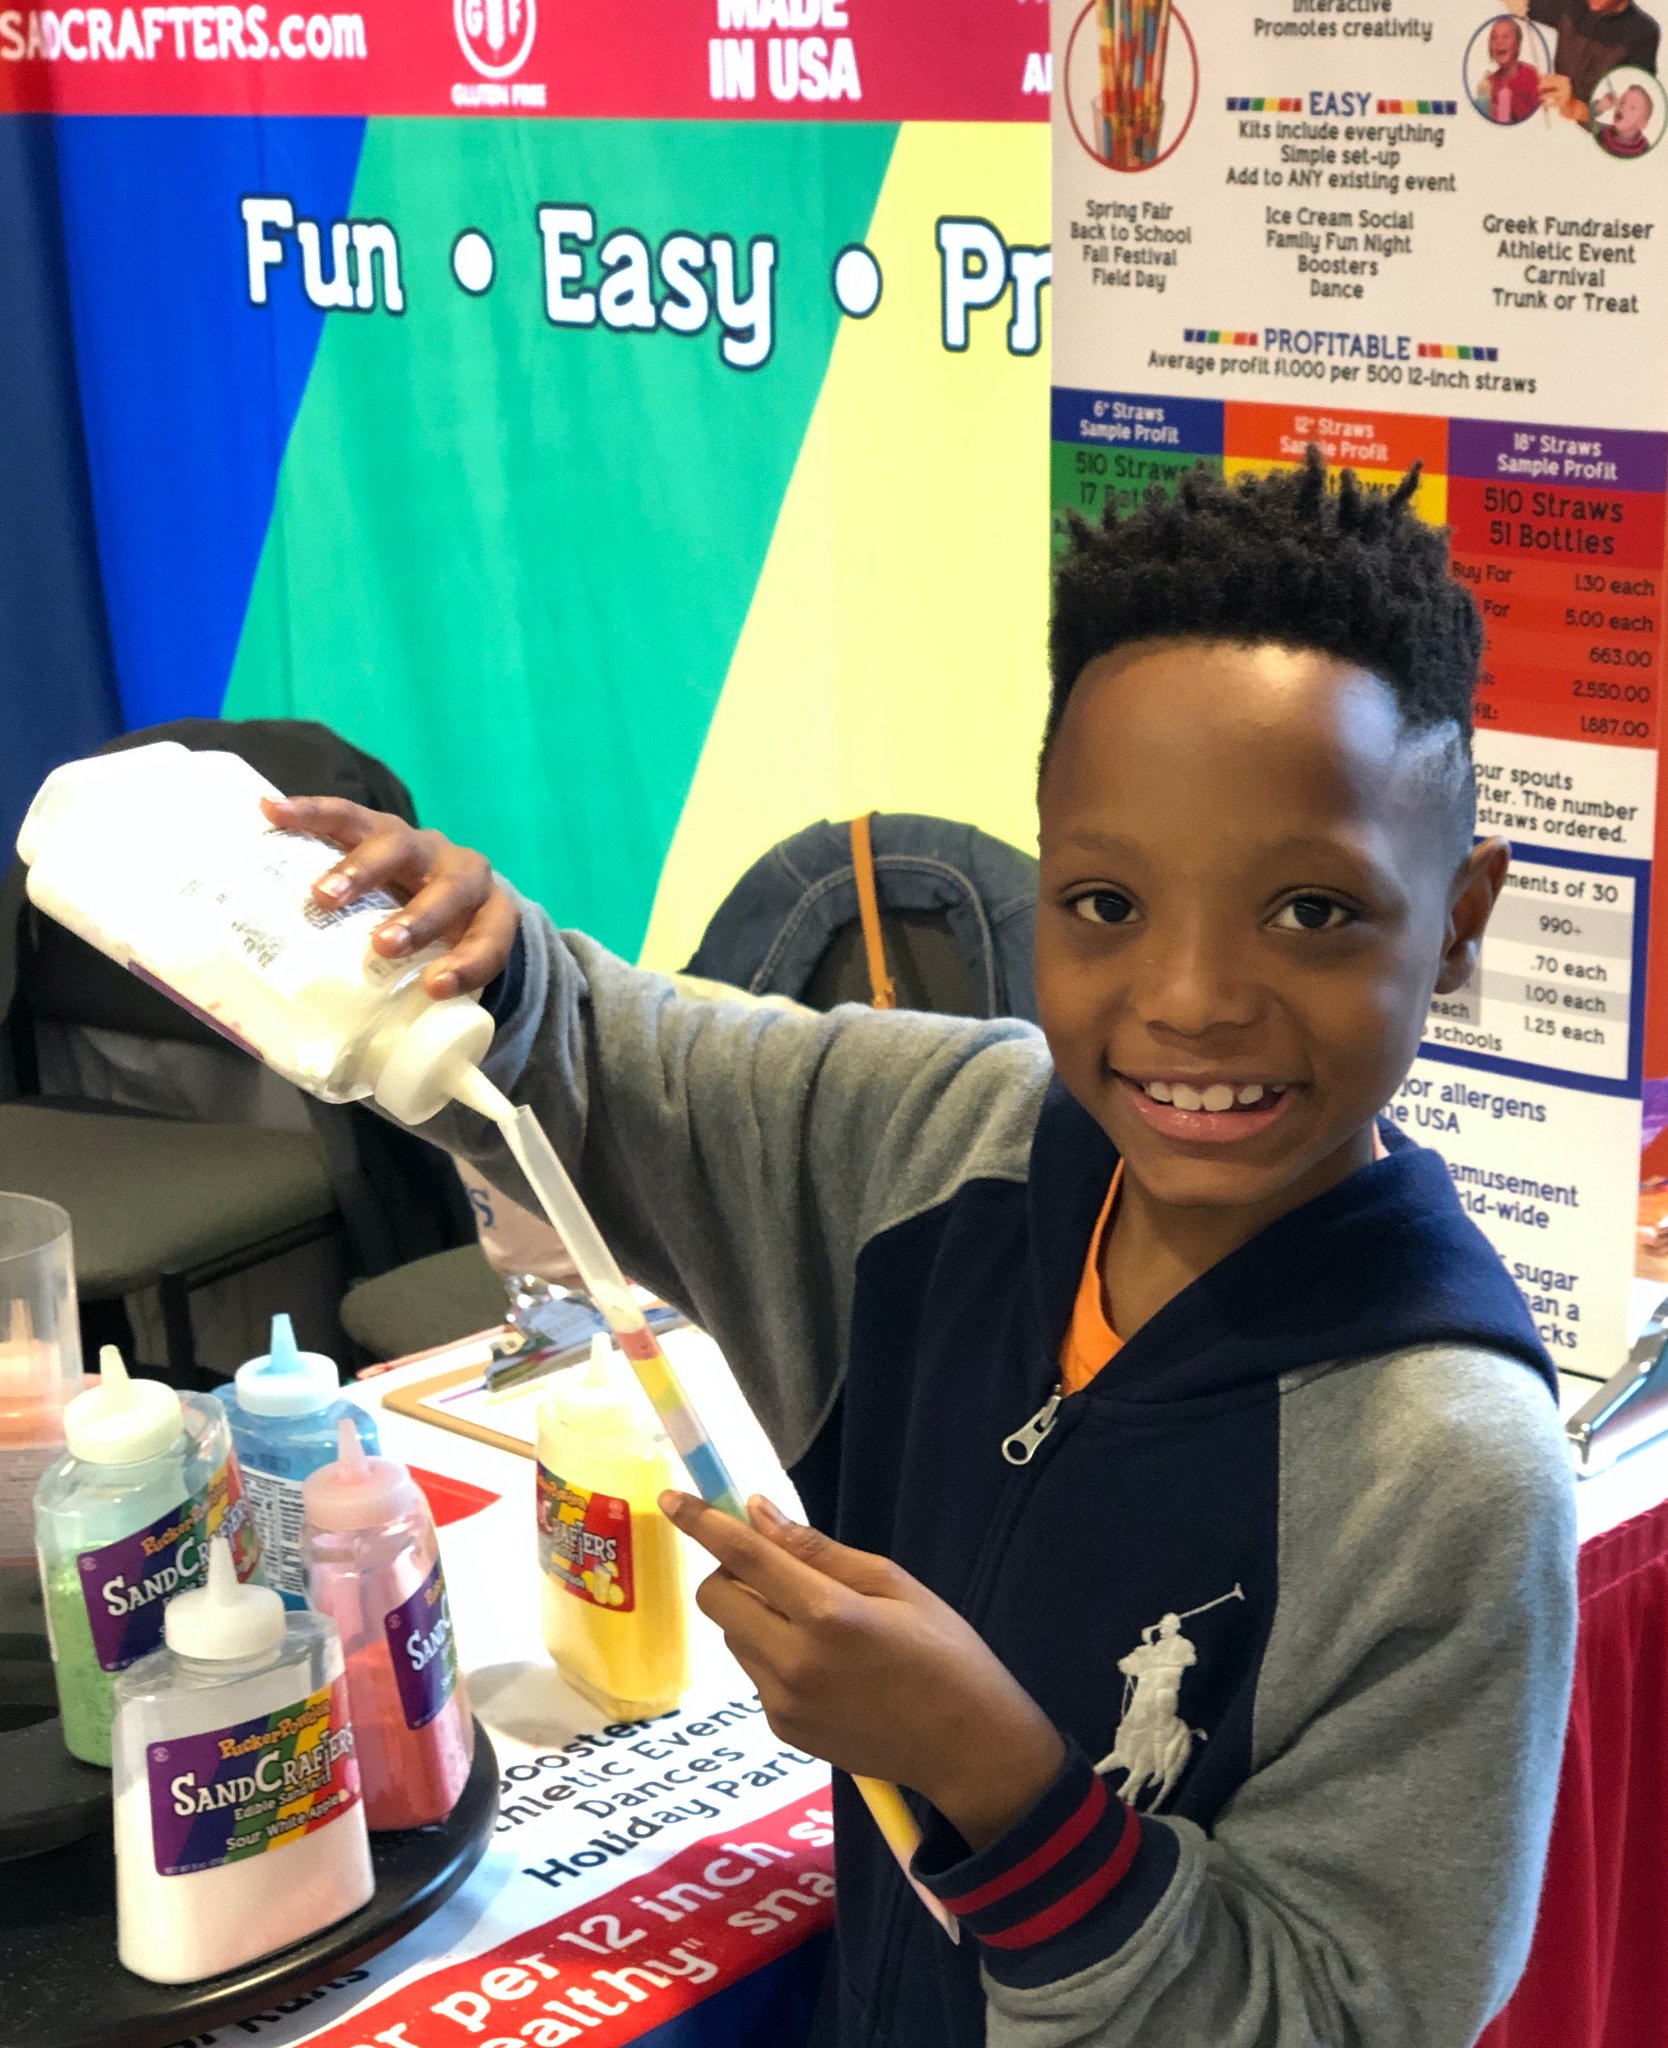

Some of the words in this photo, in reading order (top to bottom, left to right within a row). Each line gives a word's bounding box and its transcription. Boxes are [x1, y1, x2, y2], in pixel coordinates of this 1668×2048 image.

[1254, 17, 1337, 37] Promotes
[1342, 19, 1433, 42] creativity
[708, 37, 756, 100] IN
[768, 36, 862, 101] USA
[1308, 91, 1372, 116] EASY
[1238, 120, 1271, 139] Kits
[1276, 121, 1339, 141] include
[1344, 123, 1445, 147] everything
[1280, 144, 1337, 167] Simple
[1342, 147, 1401, 169] set-up
[1226, 167, 1259, 185] Add
[1264, 168, 1283, 186] to
[1287, 169, 1324, 188] ANY
[1328, 171, 1400, 194] existing
[1405, 173, 1457, 192] event
[1086, 200, 1138, 224] Spring
[1142, 202, 1174, 220] Fair
[1265, 205, 1291, 225] Ice
[1297, 207, 1353, 228] Cream
[1359, 209, 1414, 230] Social
[1070, 221, 1106, 241] Back
[1111, 224, 1129, 242] to
[1134, 224, 1192, 244] School
[1483, 214, 1538, 235] Greek
[1544, 216, 1654, 239] Fundraiser
[238, 193, 406, 317] Fun
[1082, 244, 1109, 263] Fall
[1114, 246, 1178, 267] Festival
[1266, 229, 1321, 254] Family
[1326, 232, 1358, 251] Fun
[1364, 234, 1413, 258] Night
[1497, 239, 1573, 262] Athletic
[1579, 242, 1636, 264] Event
[1297, 254, 1379, 277] Boosters
[1524, 265, 1606, 288] Carnival
[535, 202, 780, 374] Easy
[1092, 267, 1131, 287] Field
[1136, 269, 1167, 294] Day
[1310, 278, 1365, 299] Dance
[1493, 287, 1548, 309] Trunk
[1554, 294, 1578, 310] or
[1583, 292, 1640, 313] Treat
[1264, 328, 1411, 362] PROFITABLE
[1148, 349, 1215, 375] Average
[1220, 355, 1270, 376] profit
[1330, 364, 1360, 384] per
[1366, 364, 1402, 384] 500
[1408, 366, 1470, 390] 12-inch
[1475, 372, 1537, 395] straws
[1112, 402, 1165, 423] Straws
[1079, 418, 1132, 442] Sample
[1134, 423, 1180, 445] Profit
[1318, 417, 1375, 440] Straws
[1340, 440, 1389, 462] Profit
[1540, 434, 1603, 458] Straws
[1075, 450, 1109, 475] 510
[1497, 453, 1560, 478] Sample
[1564, 459, 1619, 482] Profit
[1080, 481, 1098, 506] 17
[1483, 485, 1524, 515] 510
[1531, 490, 1624, 524] Straws
[1489, 520, 1511, 546] 51
[1518, 522, 1616, 556] Bottles
[1486, 563, 1514, 584] For
[1610, 578, 1656, 597] each
[1483, 599, 1511, 618] For
[1564, 607, 1604, 629] 5.00
[1608, 614, 1655, 633] each
[1589, 646, 1653, 669] 663.00
[1510, 767, 1574, 792] spouts
[1522, 789, 1558, 811] The
[1562, 798, 1639, 822] number
[1478, 808, 1538, 831] straws
[1543, 818, 1628, 844] ordered.
[1565, 880, 1586, 899] of
[1592, 883, 1619, 904] 30
[1538, 914, 1583, 938] 990+
[1530, 955, 1559, 974] .70
[1564, 962, 1608, 982] each
[1430, 1000, 1471, 1020] each
[1525, 984, 1558, 1005] 1.00
[1562, 992, 1607, 1014] each
[1434, 1026, 1503, 1052] schools
[1524, 1015, 1556, 1036] 1.25
[1561, 1024, 1606, 1045] each
[1440, 1082, 1547, 1123] allergens
[1415, 1104, 1462, 1135] USA
[1449, 1162, 1580, 1208] amusement
[1513, 1260, 1579, 1292] sugar
[1565, 1303, 1580, 1323] a
[629, 1694, 764, 1761] Event
[573, 1747, 746, 1820] Dances
[226, 1830, 262, 1851] Sour
[266, 1812, 306, 1837] White
[521, 1797, 722, 1888] Holiday
[430, 1952, 560, 2033] per
[557, 1914, 648, 1955] 12
[630, 1841, 795, 1924] inch
